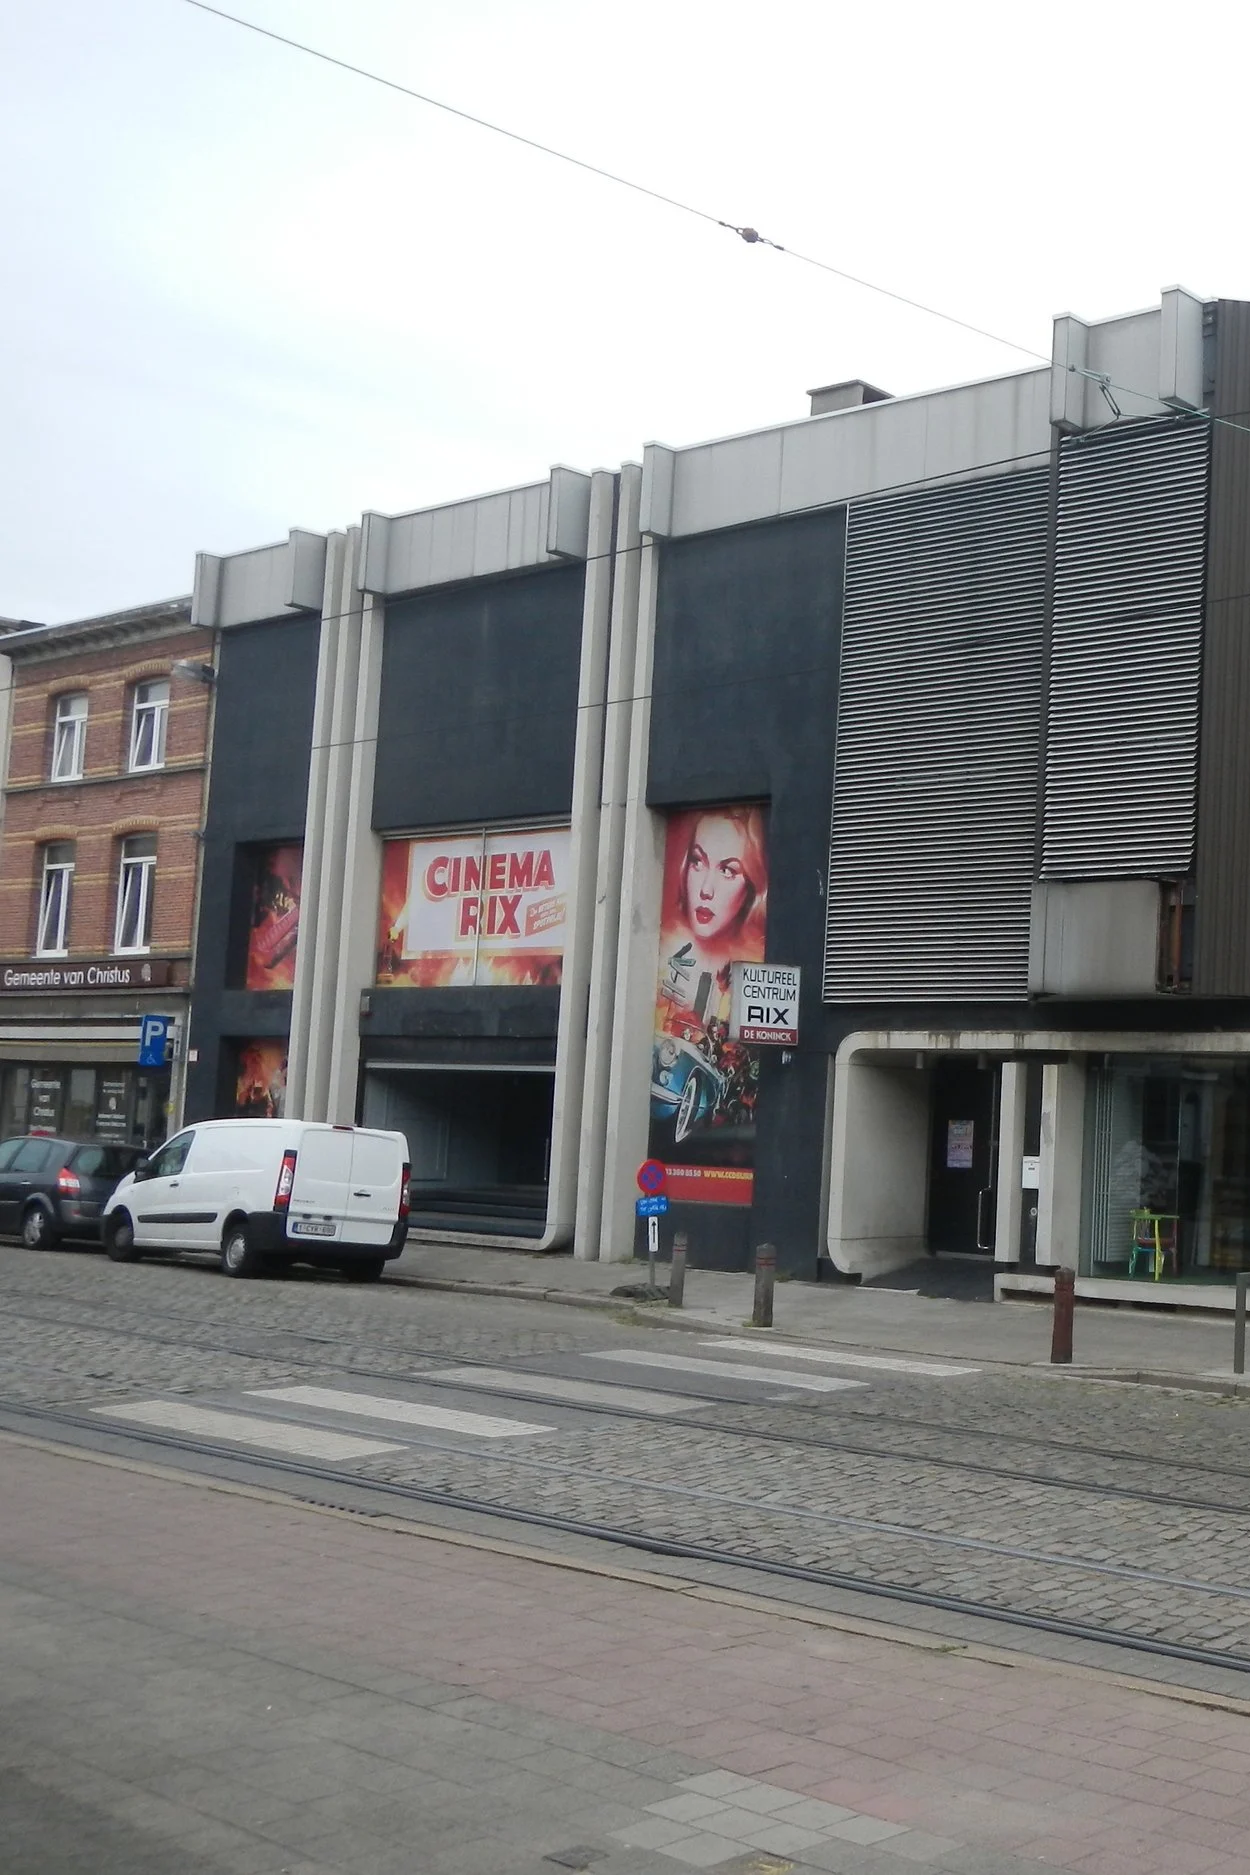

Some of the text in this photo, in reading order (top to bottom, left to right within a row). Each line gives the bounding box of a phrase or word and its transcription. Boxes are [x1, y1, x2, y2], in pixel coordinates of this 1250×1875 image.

[425, 849, 556, 899] CINEMA
[458, 893, 523, 938] RIX
[4, 966, 131, 986] Gemeente van Christus
[743, 968, 797, 986] KULTUREEL
[743, 985, 796, 1002] CENTRUM
[145, 1020, 164, 1046] P
[744, 1029, 792, 1041] DE KONINCK
